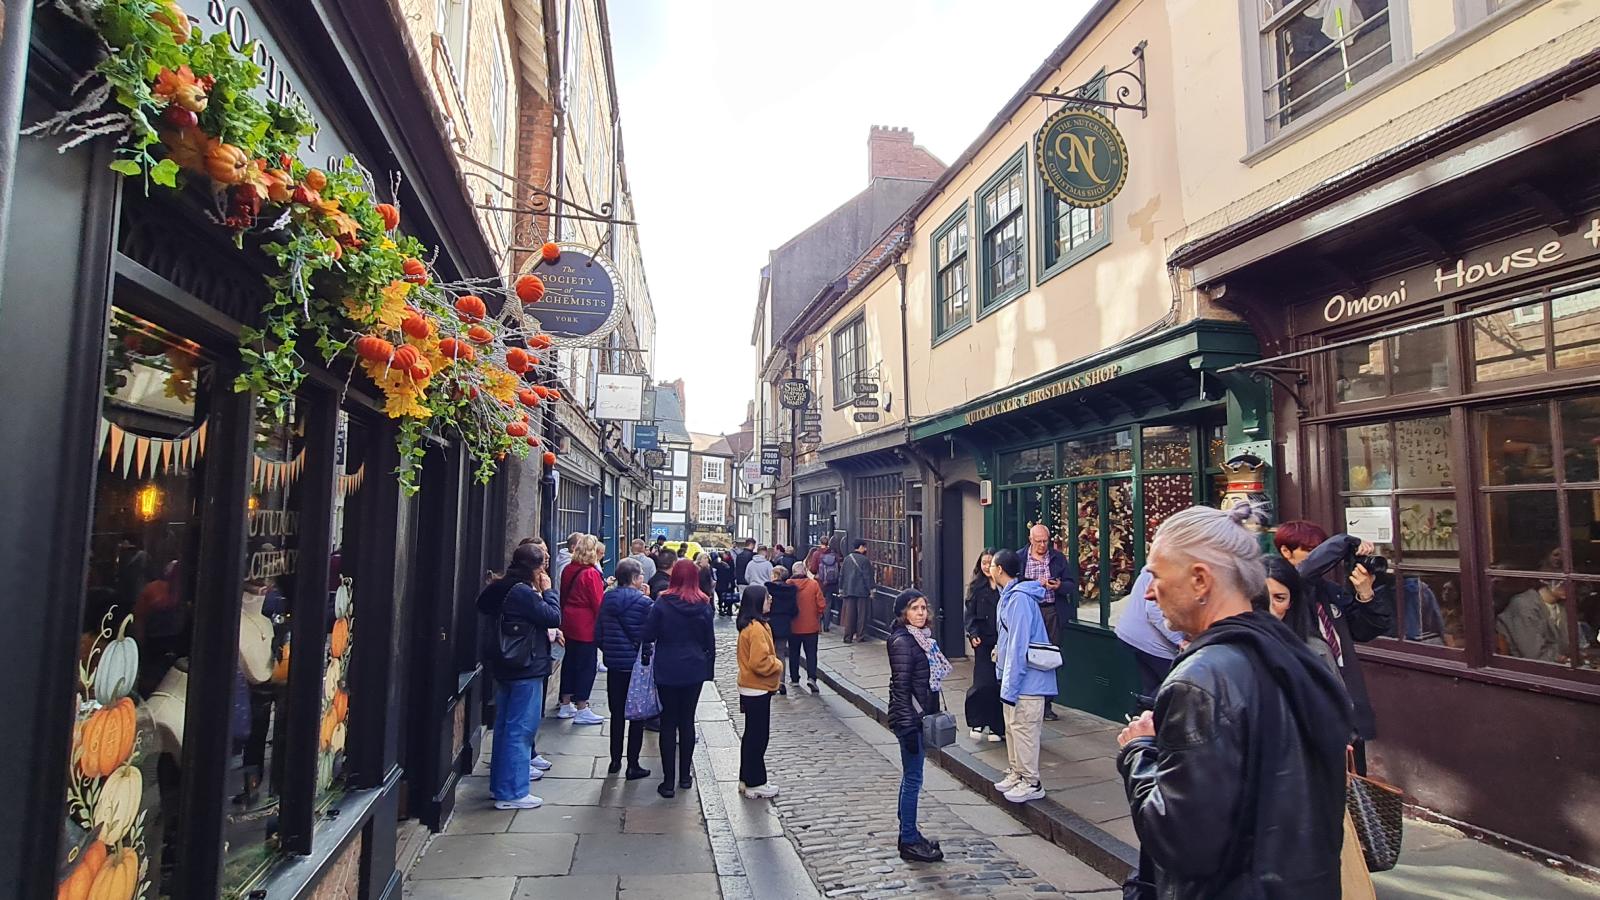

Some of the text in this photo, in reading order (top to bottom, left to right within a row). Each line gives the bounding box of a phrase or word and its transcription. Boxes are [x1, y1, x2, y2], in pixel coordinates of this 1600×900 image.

[208, 0, 321, 152] SOCIEY
[1056, 119, 1116, 153] THE NUTCRACKER
[1055, 132, 1110, 184] N
[1049, 163, 1106, 197] CHRISTMAS SHOP
[542, 274, 595, 286] SOCIETY
[1324, 240, 1565, 323] Omoni House
[539, 296, 606, 307] CHEMISTS
[964, 365, 1118, 426] NUTCRACKER CHRISTMAS SHOP
[248, 509, 301, 537] UTUMN
[243, 549, 300, 581] CHEMY
